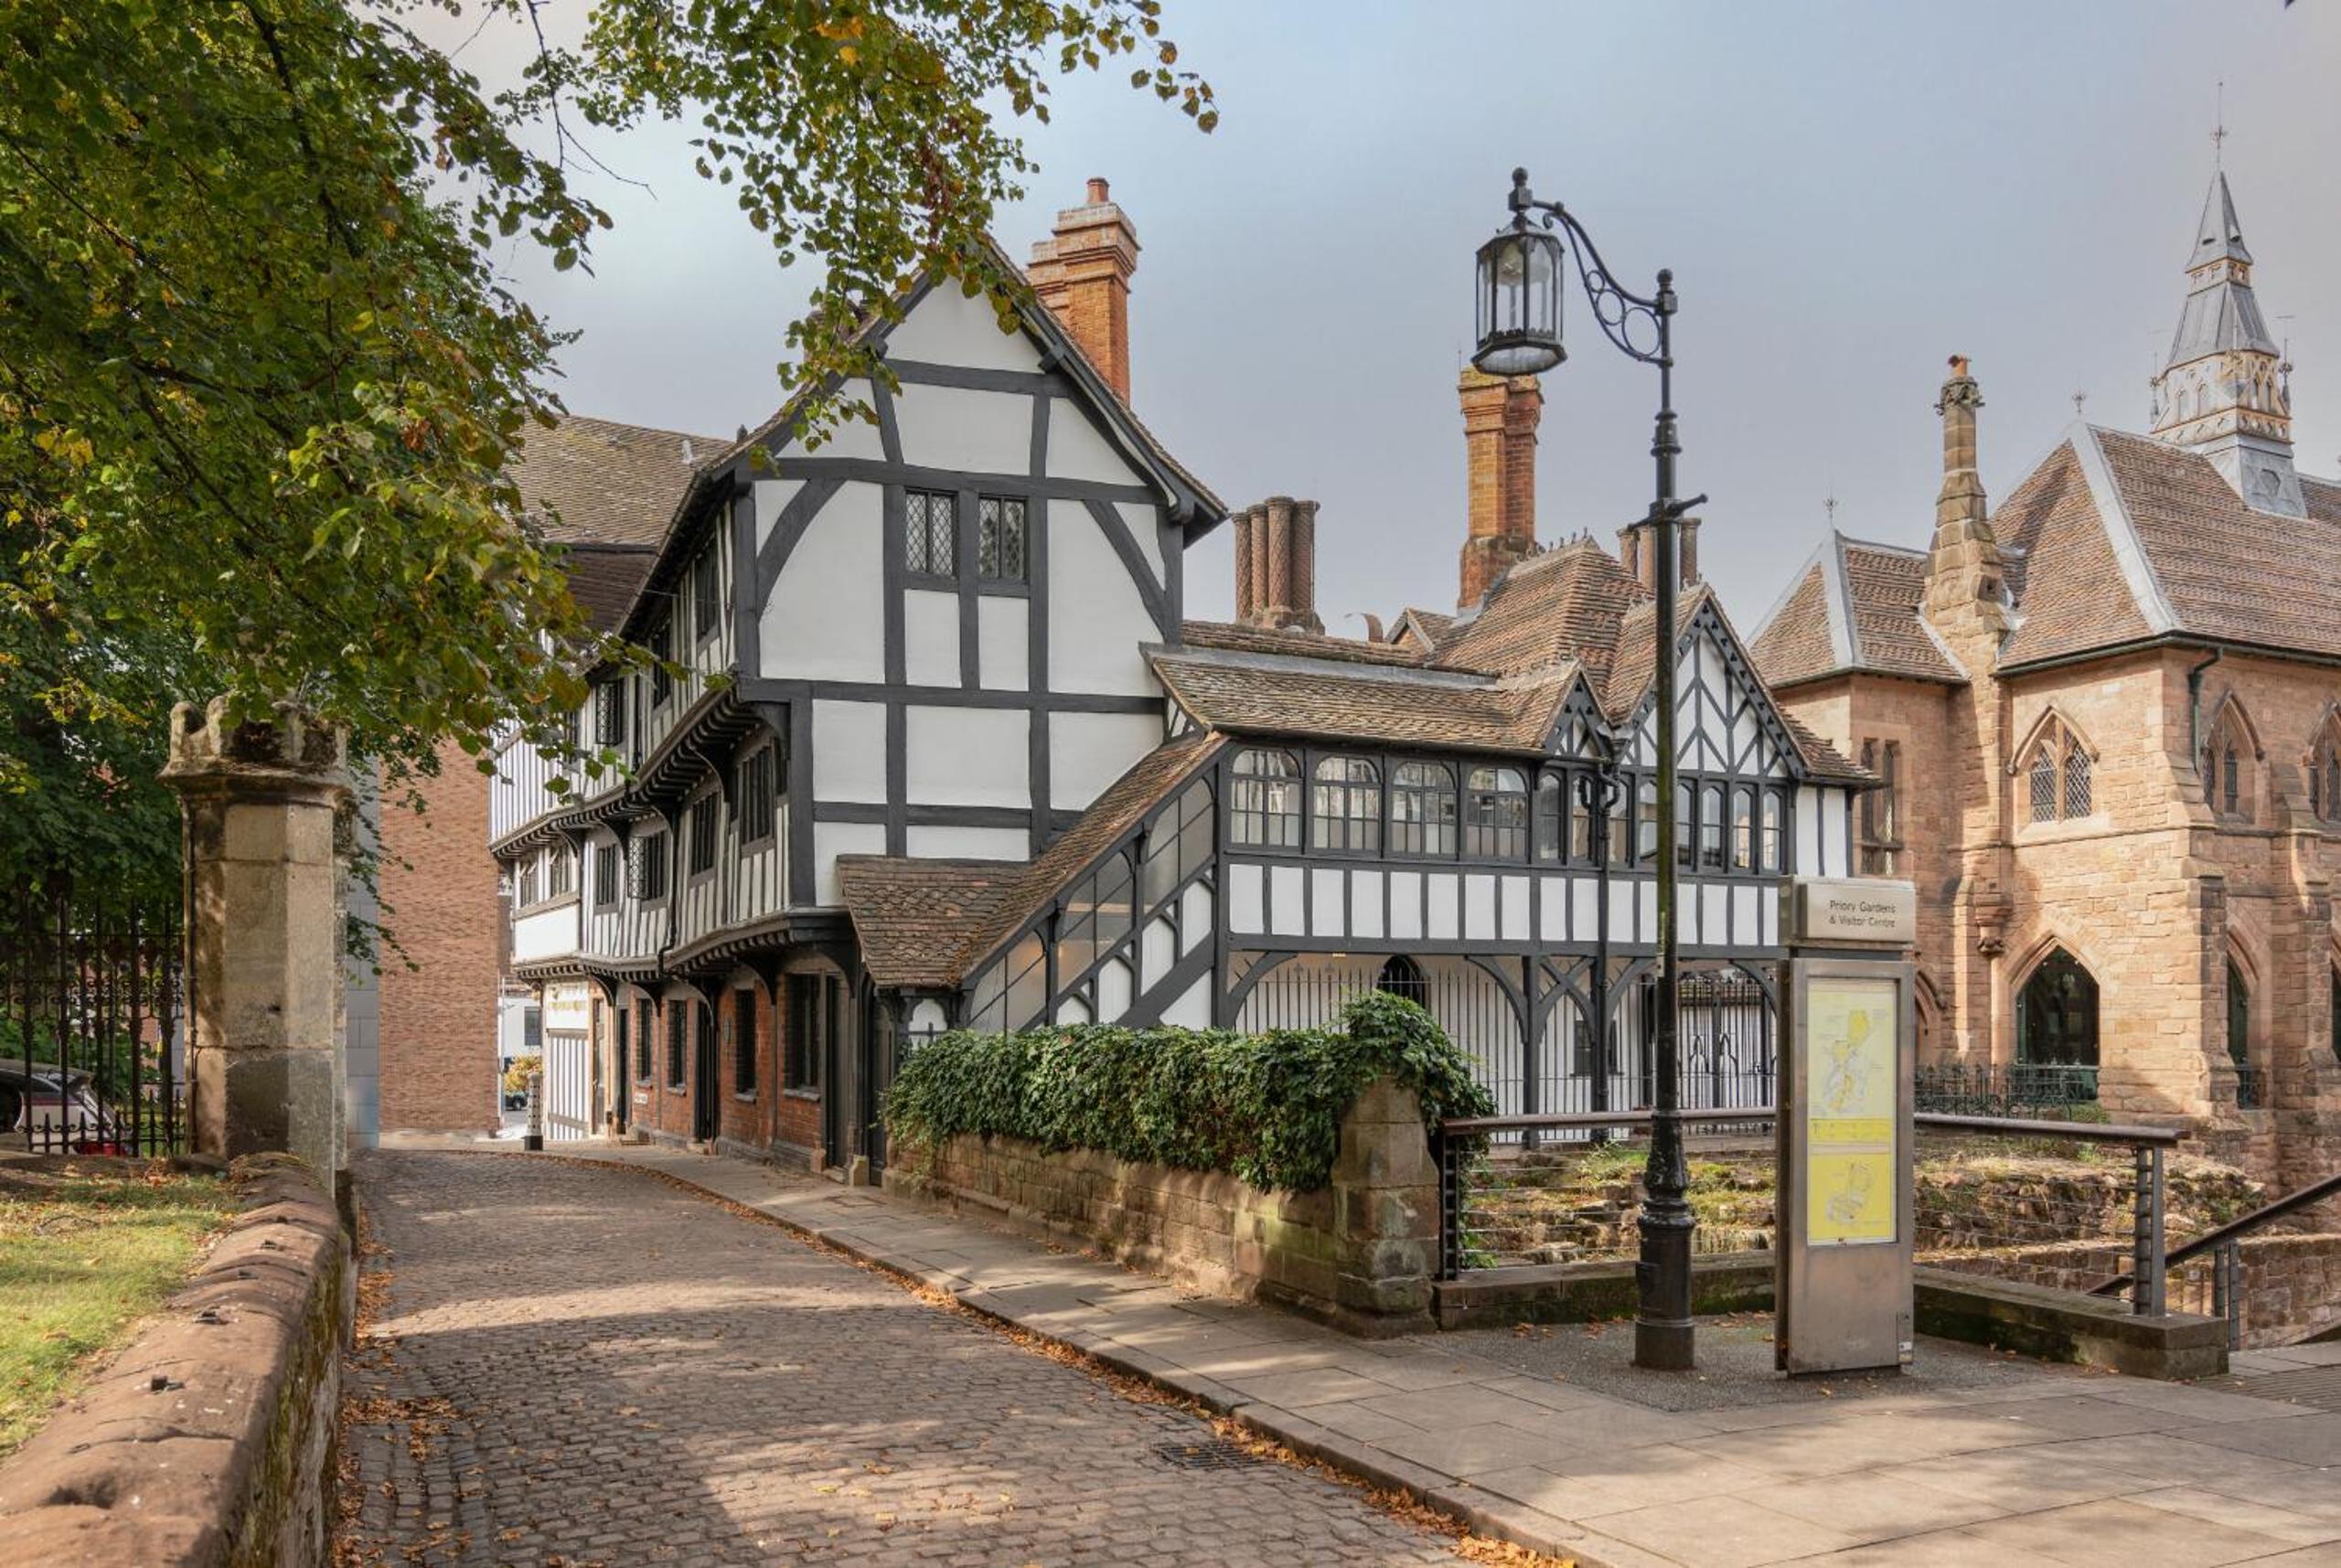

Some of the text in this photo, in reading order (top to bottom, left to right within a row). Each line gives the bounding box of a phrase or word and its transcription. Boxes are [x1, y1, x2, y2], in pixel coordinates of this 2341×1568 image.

[1830, 900, 1897, 913] Priory Gardens
[1829, 916, 1896, 927] & Visitor Centre
